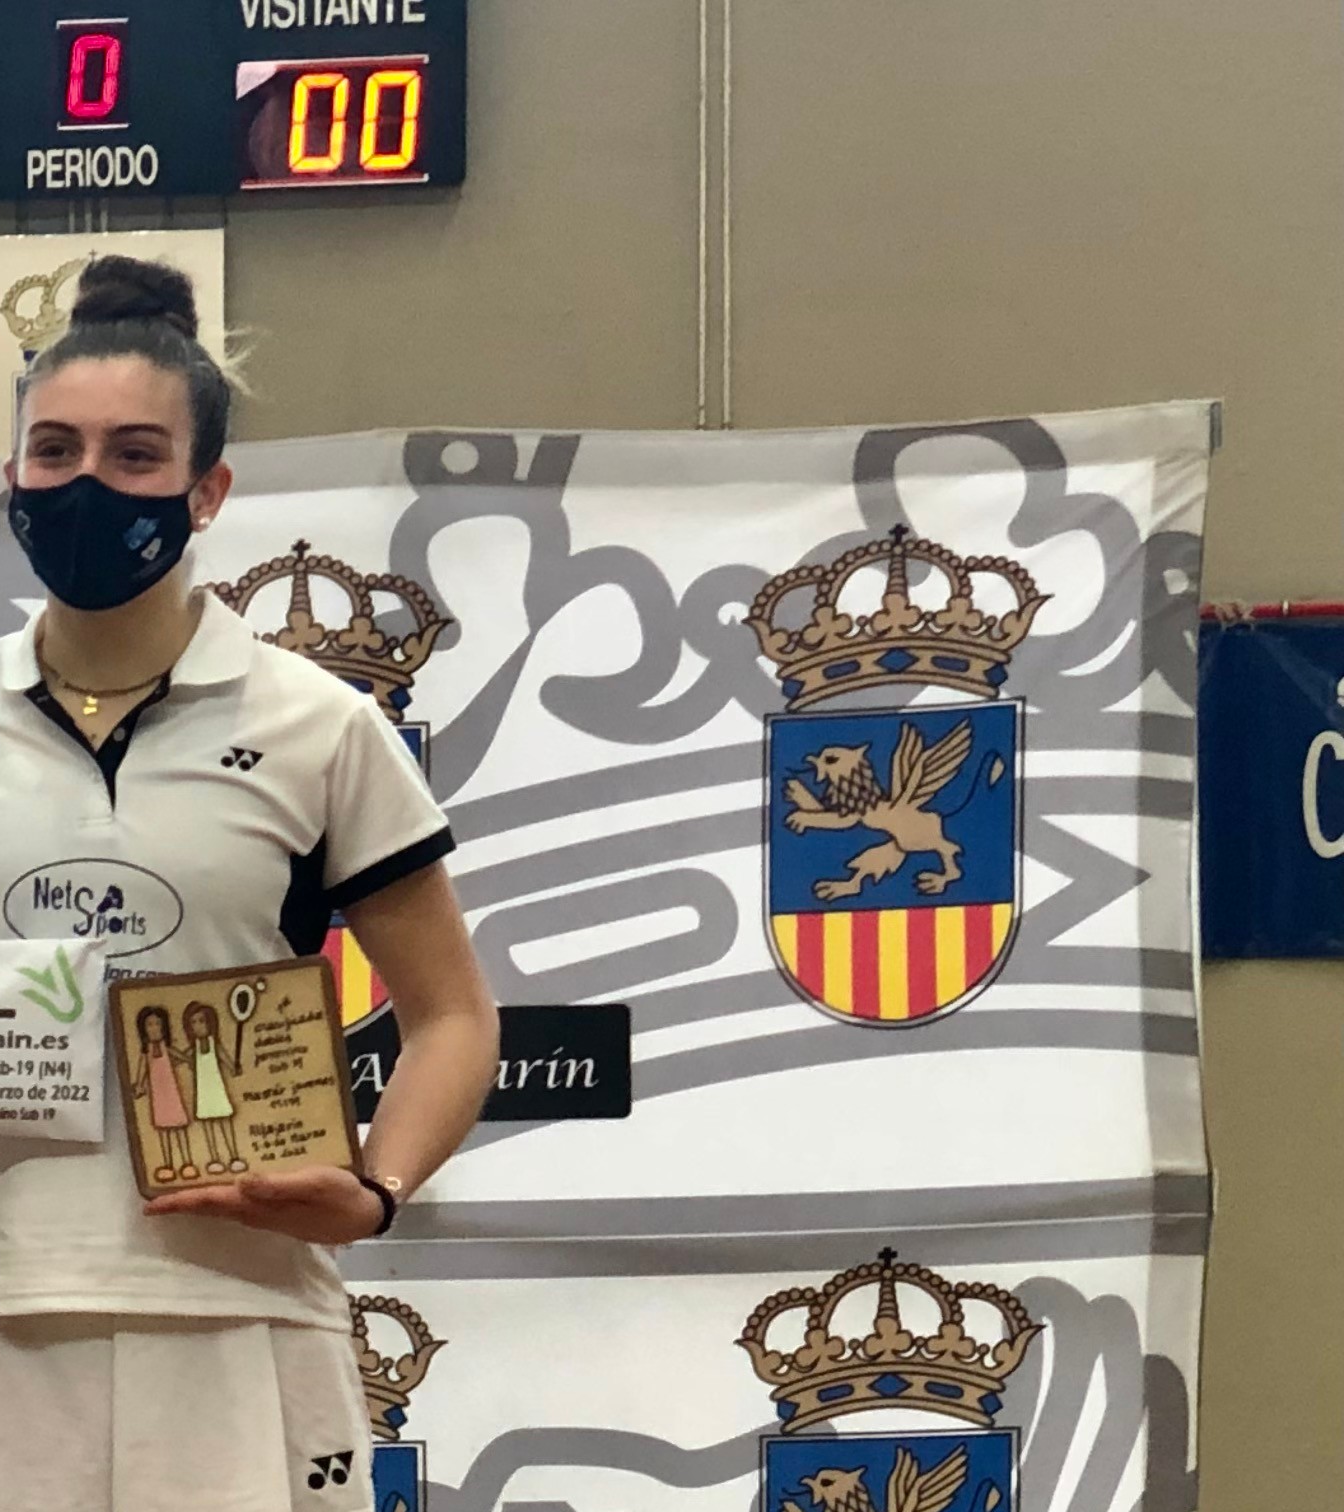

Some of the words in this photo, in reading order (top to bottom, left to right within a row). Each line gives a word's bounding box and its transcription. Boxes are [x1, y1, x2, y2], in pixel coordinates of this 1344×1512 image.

[66, 33, 121, 120] 0
[288, 70, 422, 174] 00
[26, 144, 159, 190] PERIODO
[33, 876, 72, 910] Net
[27, 1083, 48, 1100] de
[50, 1084, 91, 1102] 2022
